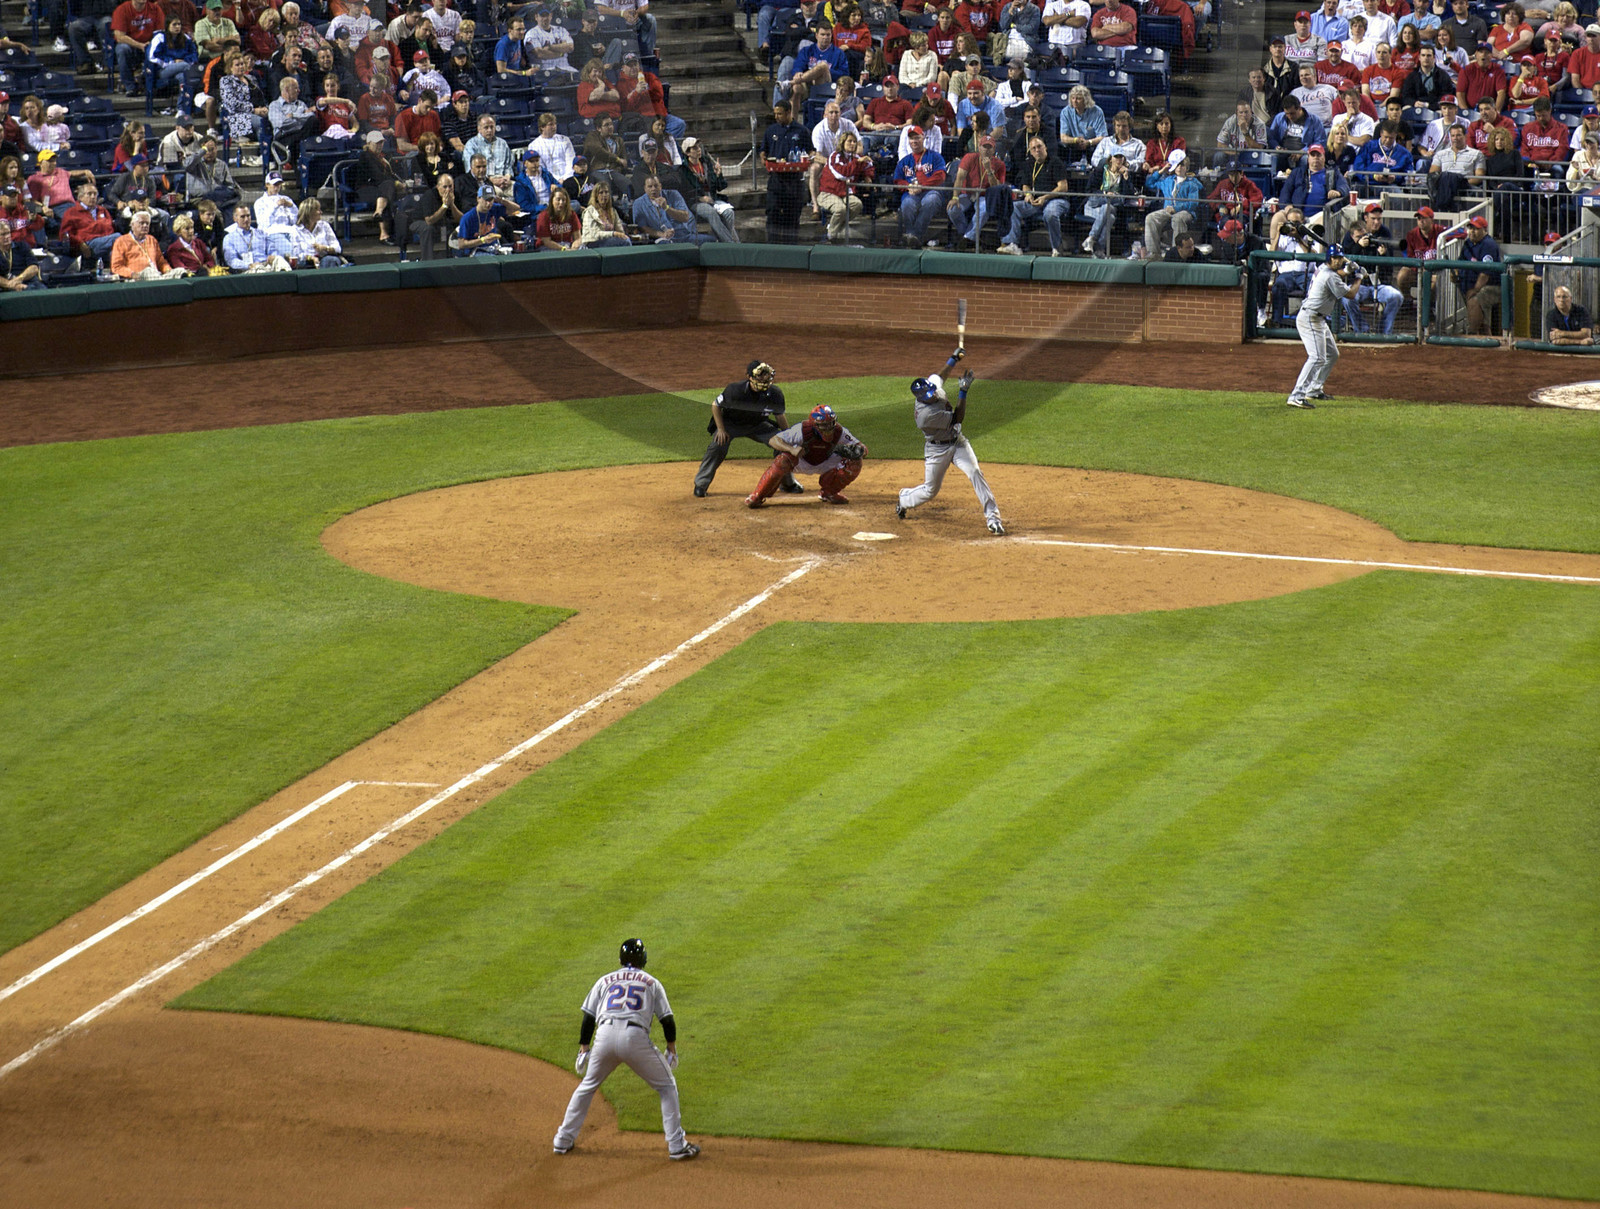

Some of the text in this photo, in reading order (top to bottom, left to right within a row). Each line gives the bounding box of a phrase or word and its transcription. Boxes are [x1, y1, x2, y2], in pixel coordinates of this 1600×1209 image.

[1286, 46, 1316, 58] Phillies
[1302, 90, 1325, 103] Mets
[1526, 132, 1560, 147] Phillies
[604, 972, 654, 987] FELICIANO
[606, 984, 646, 1011] 25
